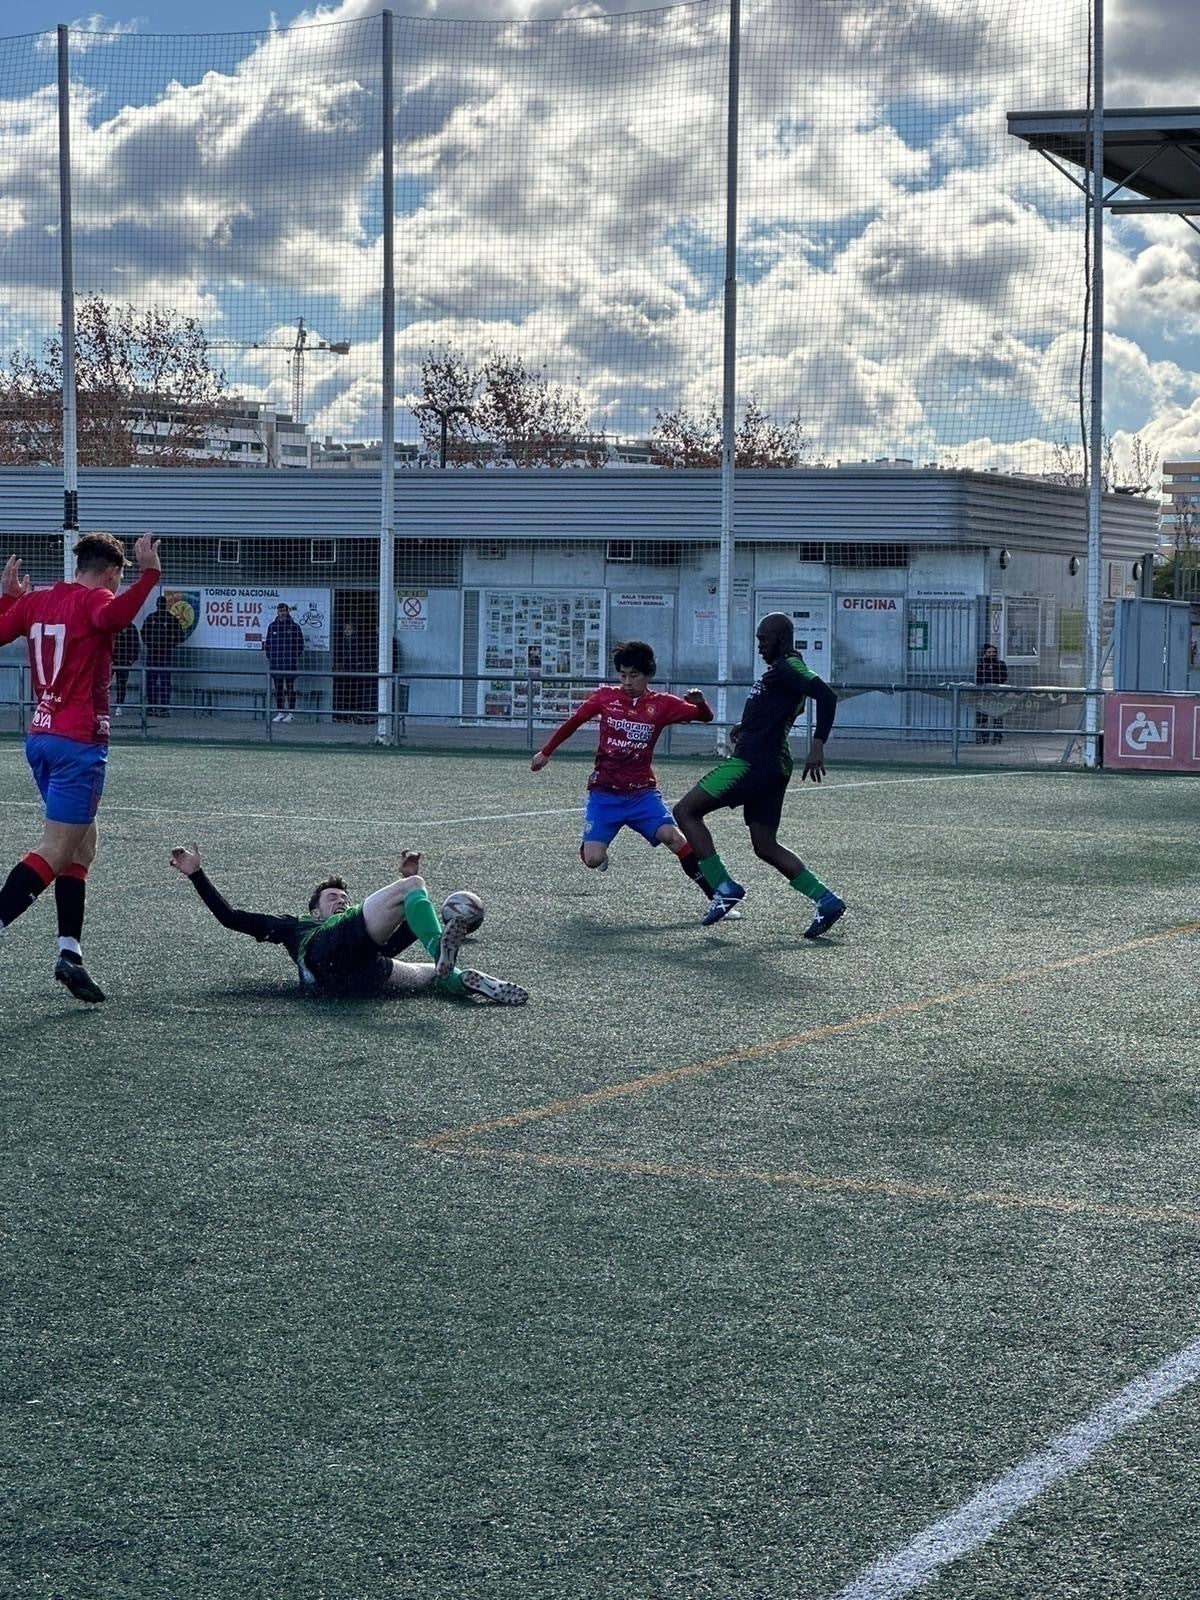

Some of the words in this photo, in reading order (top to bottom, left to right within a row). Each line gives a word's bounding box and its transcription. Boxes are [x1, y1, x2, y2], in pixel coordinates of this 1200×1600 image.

[205, 588, 237, 597] TORNEO
[238, 588, 280, 598] NACIONAL
[205, 599, 233, 615] JOSÉ
[236, 601, 263, 615] LUIS
[842, 598, 897, 610] OFICINA
[207, 615, 261, 628] VIOLETA
[29, 622, 66, 687] 17
